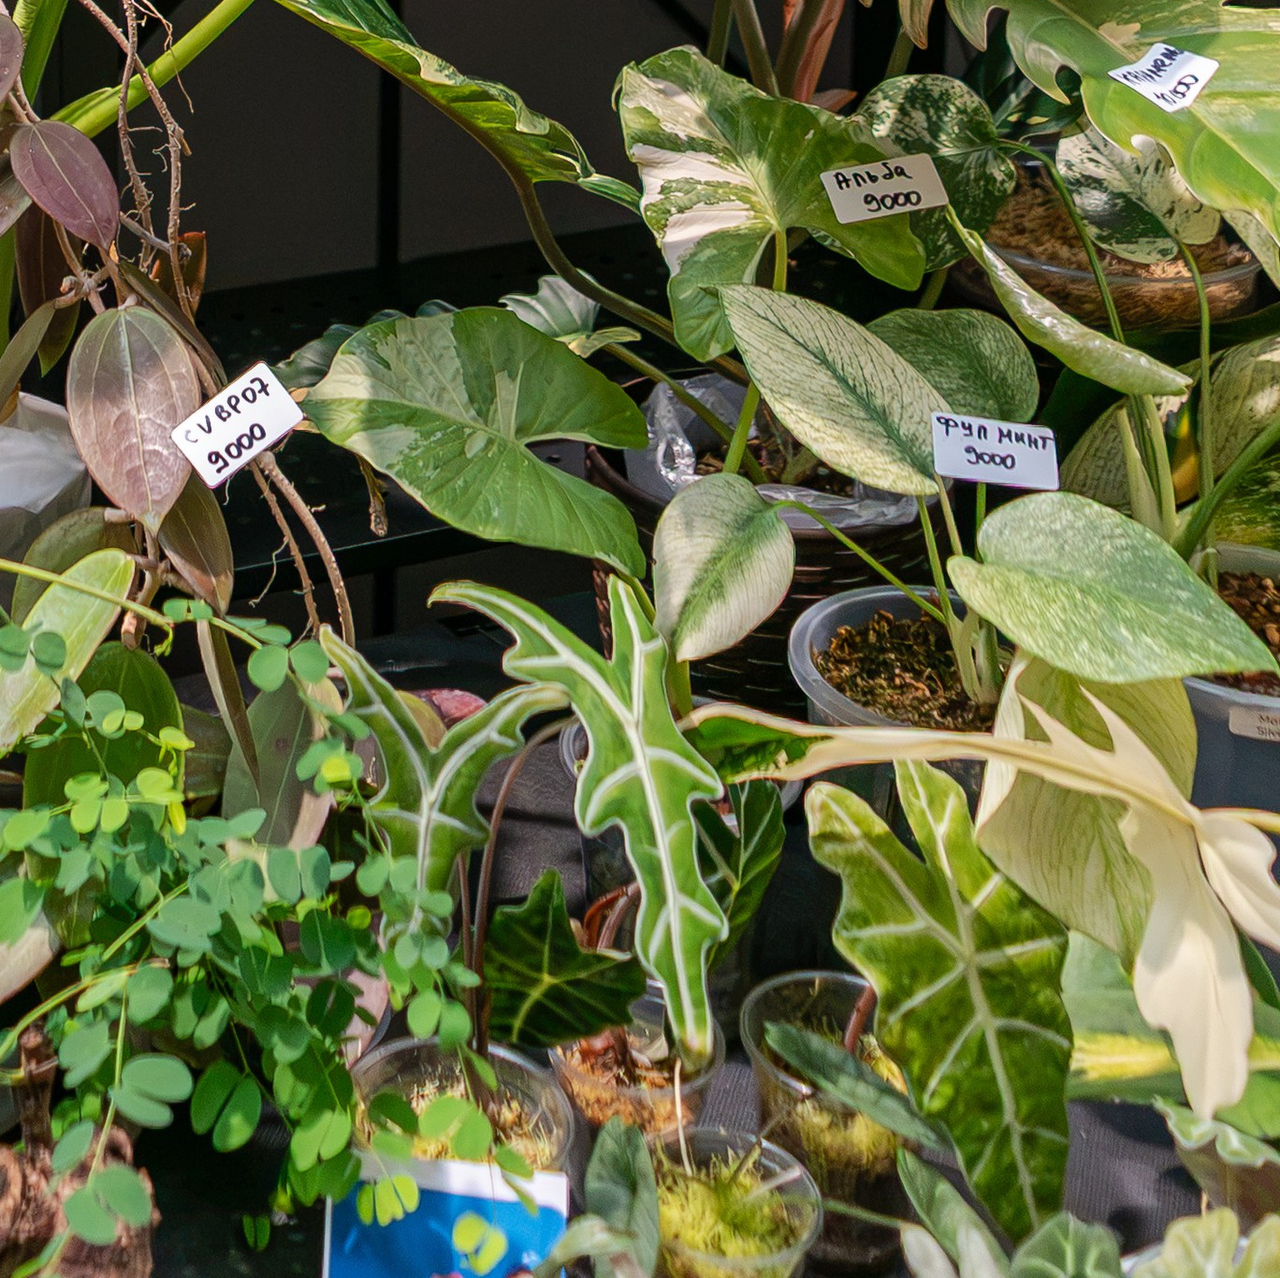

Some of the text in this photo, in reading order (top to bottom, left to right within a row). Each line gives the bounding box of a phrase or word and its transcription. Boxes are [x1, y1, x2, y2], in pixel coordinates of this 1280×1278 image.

[863, 190, 922, 213] 9000
[207, 422, 267, 474] 9000
[964, 445, 1016, 470] 9000
